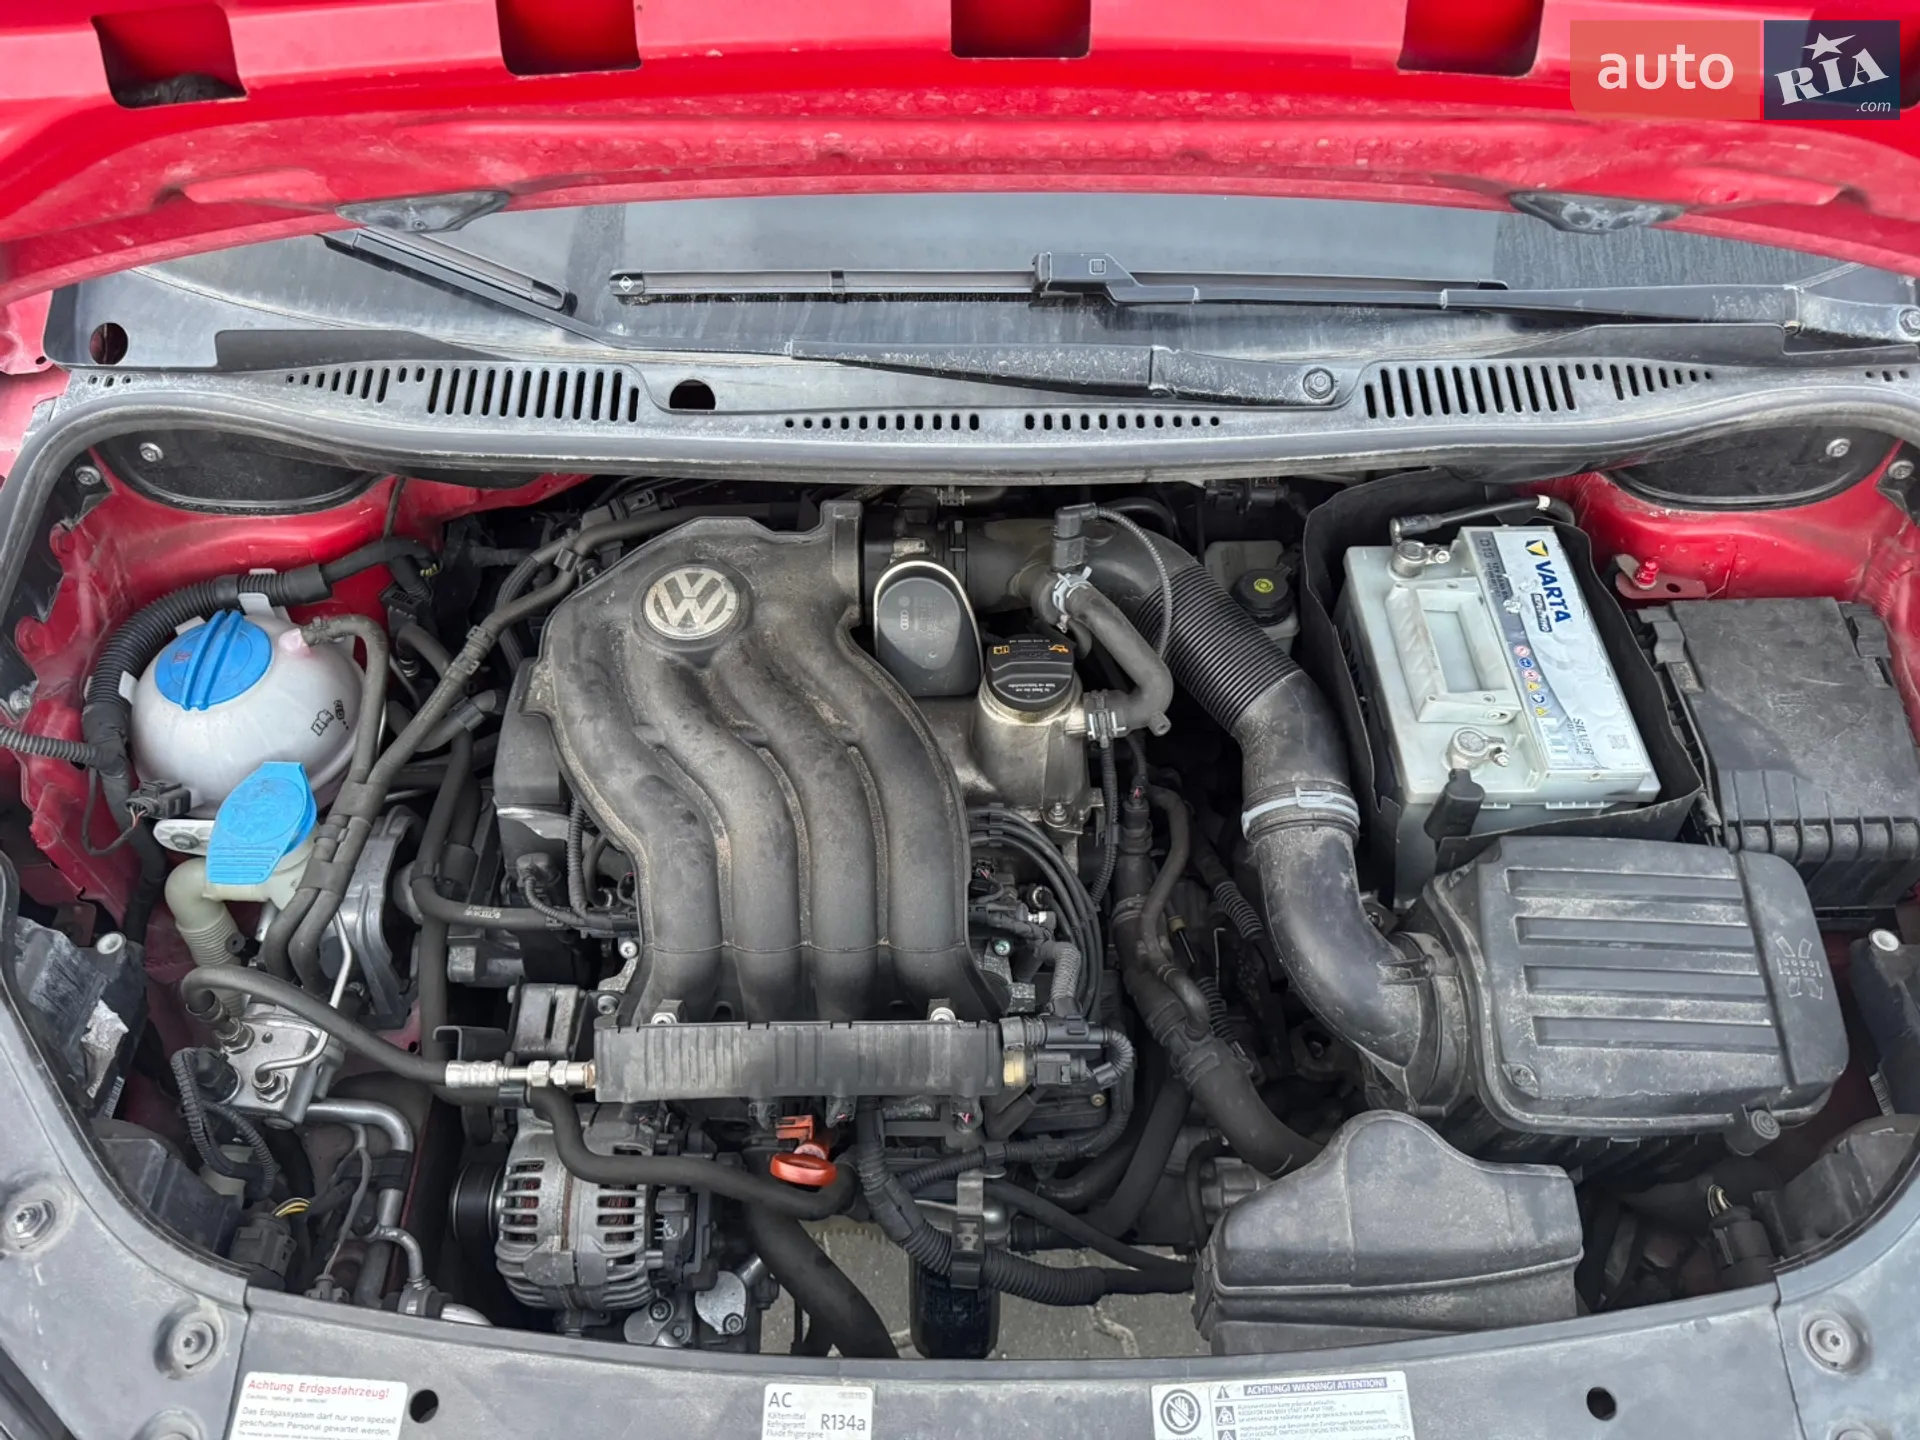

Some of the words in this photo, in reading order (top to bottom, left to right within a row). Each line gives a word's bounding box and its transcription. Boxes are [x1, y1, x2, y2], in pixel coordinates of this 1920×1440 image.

[1535, 560, 1572, 623] VARTA
[644, 566, 739, 639] VW
[1573, 718, 1595, 755] SILVER
[247, 1379, 294, 1394] Achtung
[298, 1382, 390, 1400] Erdgasfahrzeug!
[768, 1392, 792, 1408] AC
[241, 1406, 257, 1415] Das
[260, 1407, 315, 1419] Erdgassystem
[316, 1411, 333, 1420] darf
[335, 1413, 348, 1421] nur
[820, 1413, 866, 1431] R134a
[287, 1421, 321, 1431] Personal
[323, 1425, 359, 1433] gewartet
